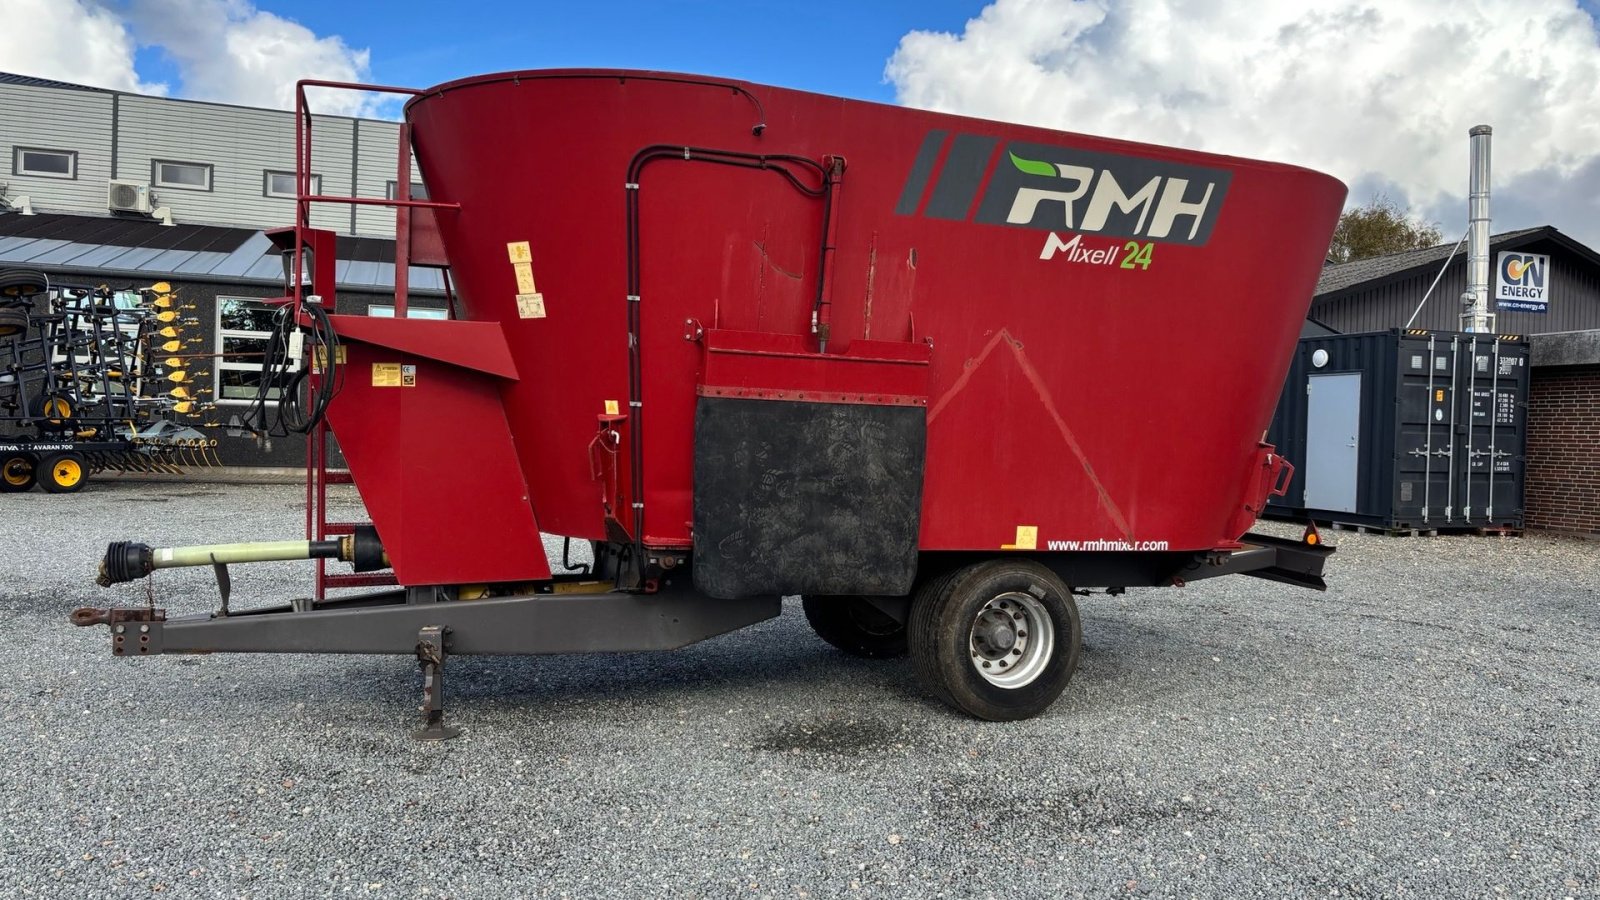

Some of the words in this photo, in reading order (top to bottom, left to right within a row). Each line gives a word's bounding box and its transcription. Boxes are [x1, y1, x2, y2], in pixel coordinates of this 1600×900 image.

[1007, 150, 1215, 241] RMH
[1039, 231, 1119, 266] Mixell
[1120, 241, 1154, 270] 24
[1501, 254, 1545, 288] CN
[1498, 301, 1546, 311] www.cn-energy.dk
[1502, 285, 1544, 299] ENERGY
